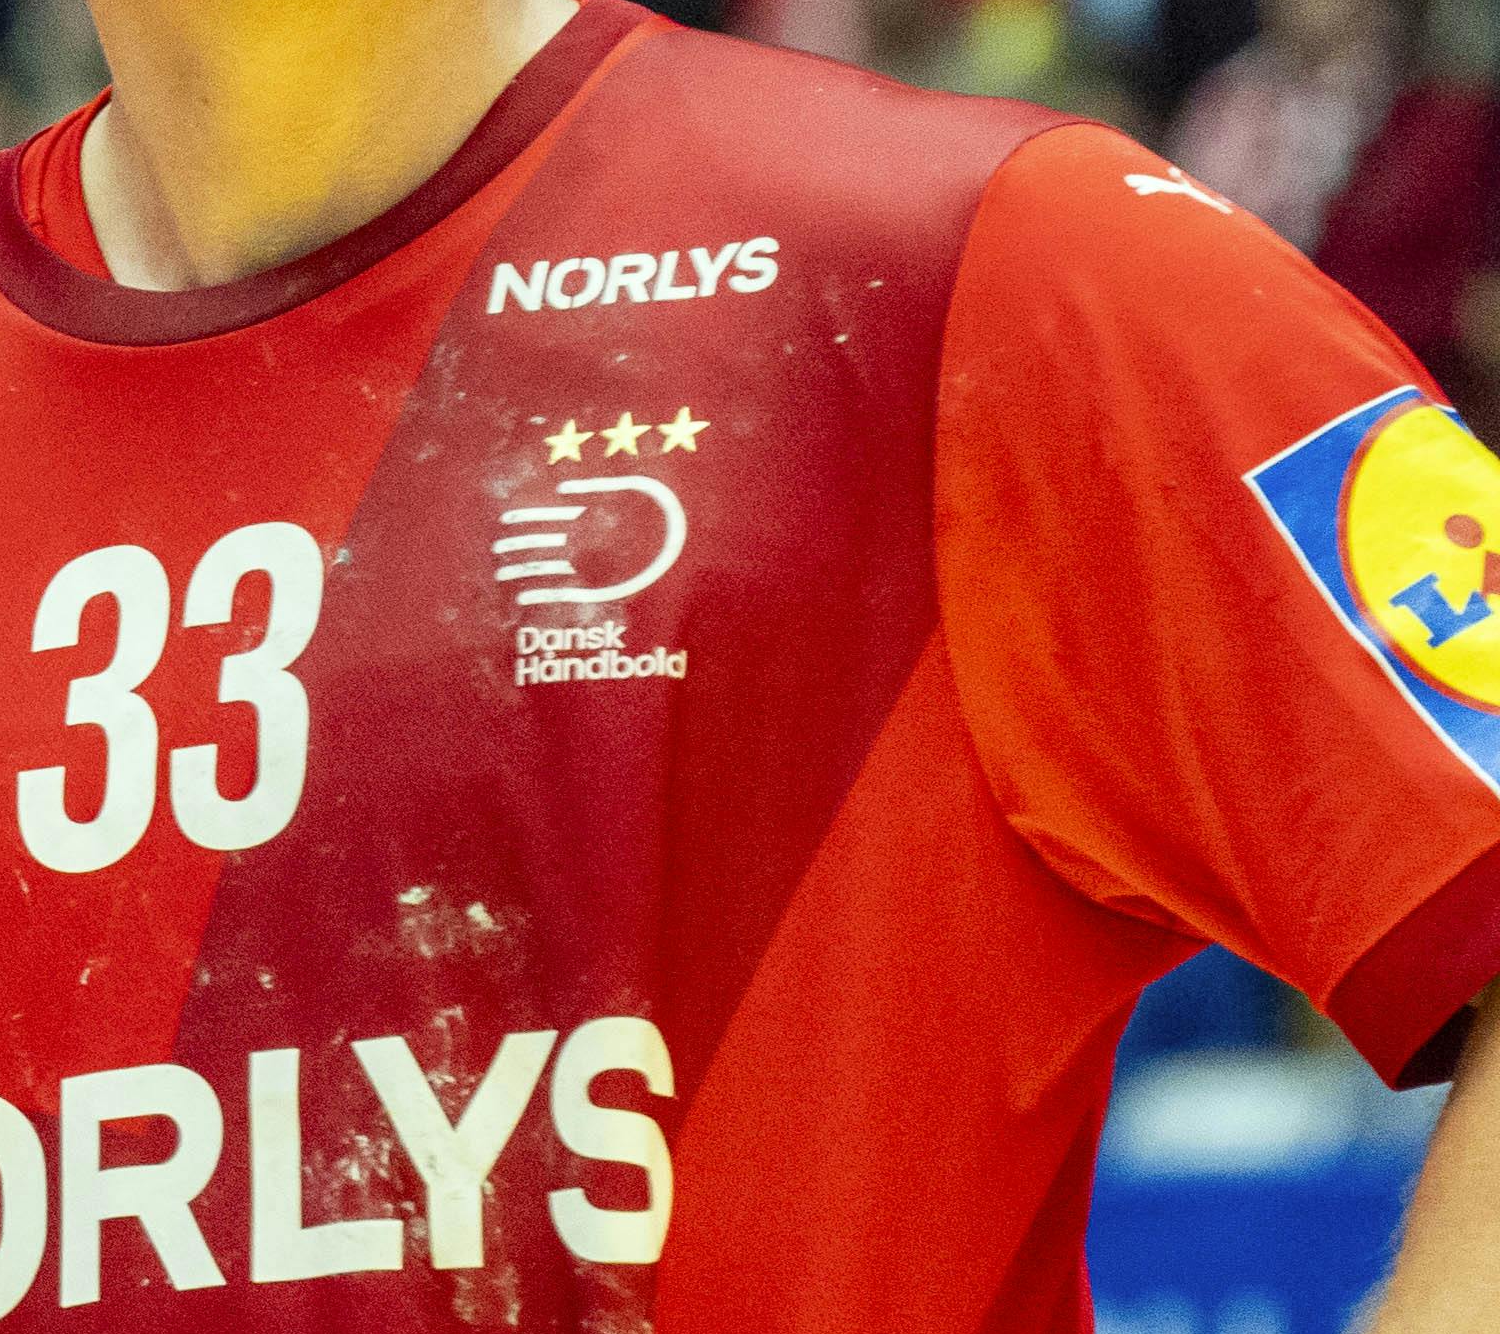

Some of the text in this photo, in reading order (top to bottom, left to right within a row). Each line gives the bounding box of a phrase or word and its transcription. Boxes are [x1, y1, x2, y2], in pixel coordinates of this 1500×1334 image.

[487, 236, 780, 315] NORLYS
[515, 647, 687, 687] Håndbold
[517, 620, 627, 655] Dansk
[16, 521, 325, 873] 33
